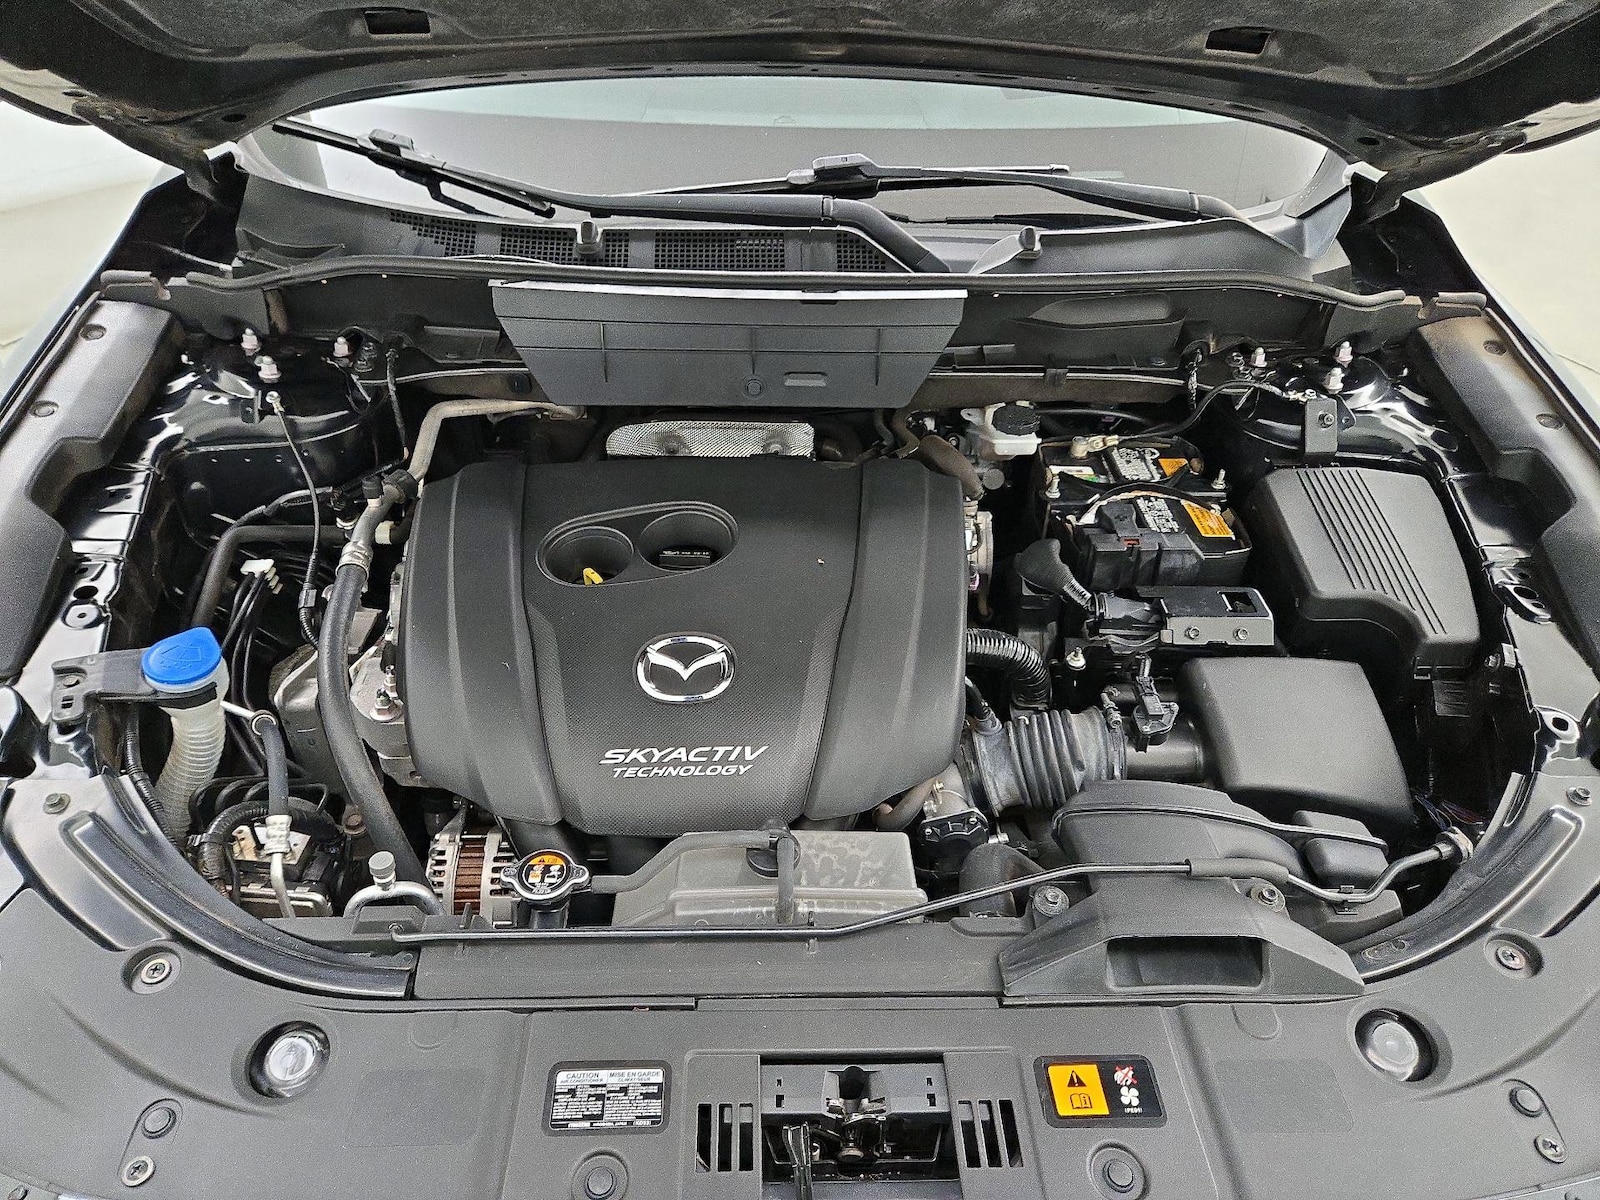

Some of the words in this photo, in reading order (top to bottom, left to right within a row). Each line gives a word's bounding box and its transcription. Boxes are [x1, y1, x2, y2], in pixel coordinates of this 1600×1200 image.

[599, 745, 770, 765] SKYACTIV
[613, 764, 754, 779] TECHNOLOGY
[566, 1072, 600, 1080] CAUTION
